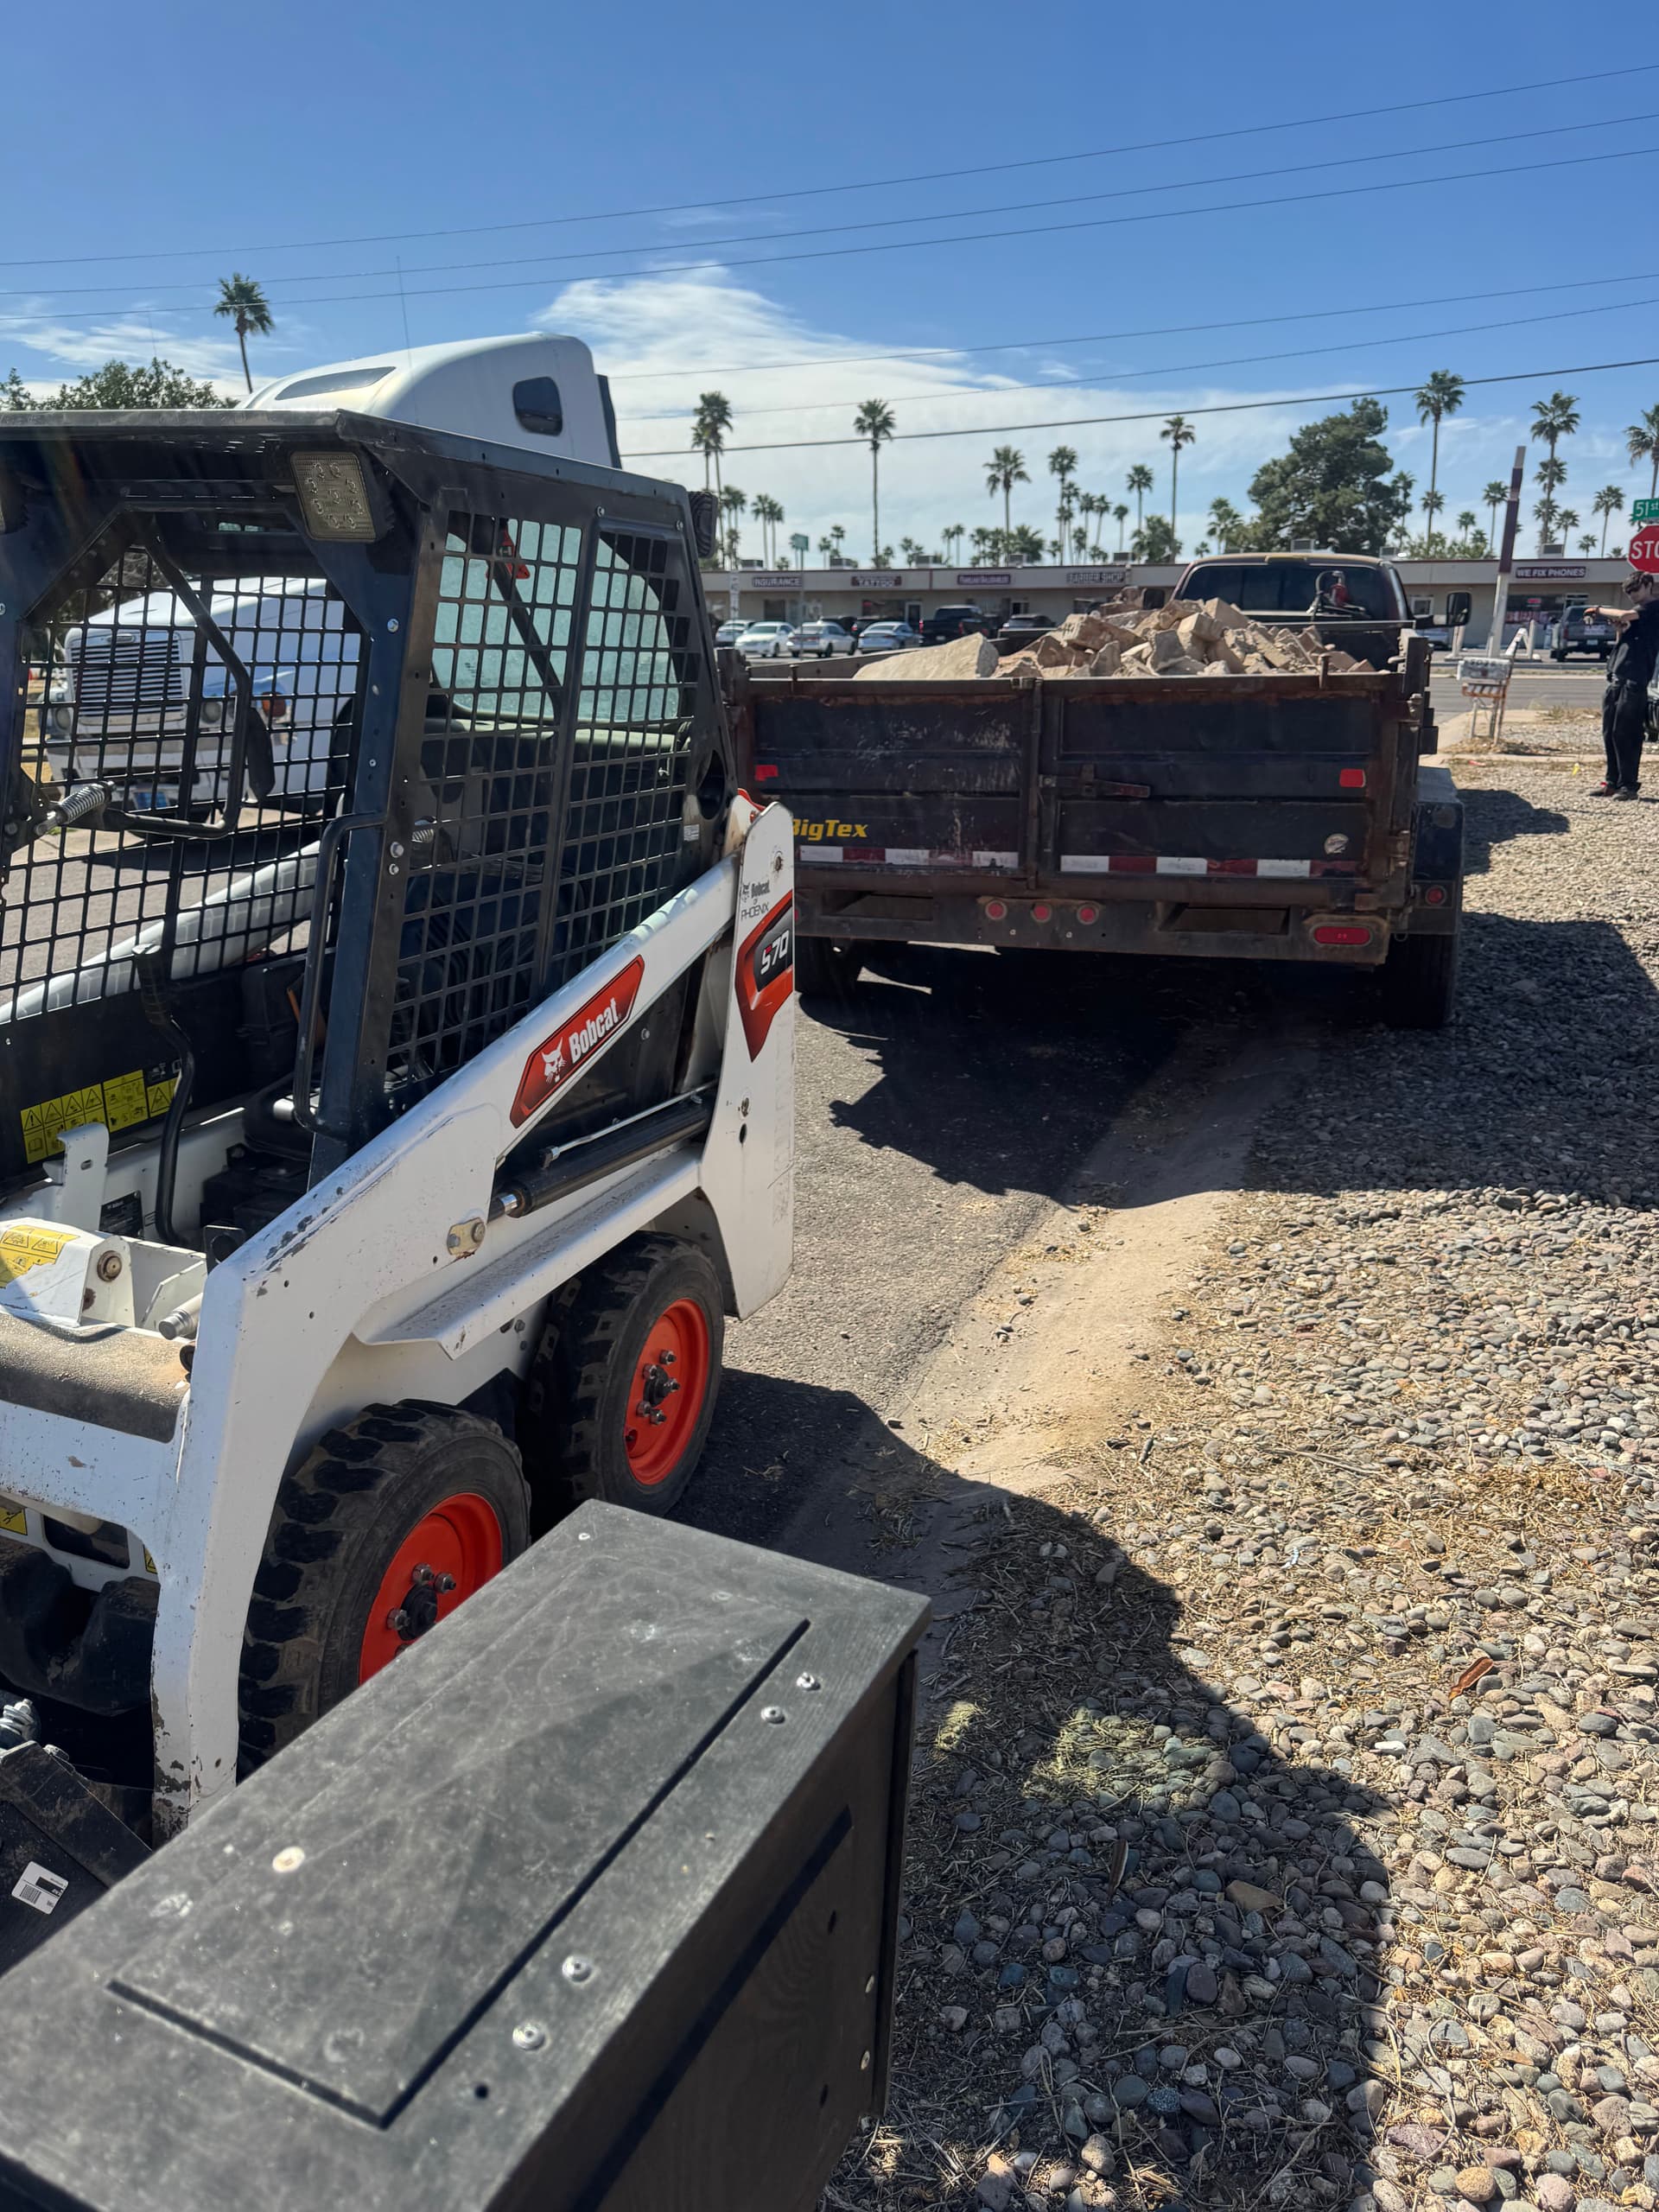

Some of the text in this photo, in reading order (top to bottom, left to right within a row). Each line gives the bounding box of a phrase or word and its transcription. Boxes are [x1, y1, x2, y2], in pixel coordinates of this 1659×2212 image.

[1517, 568, 1586, 577] WE FIX PHONES
[753, 577, 802, 588] INSURANCE
[751, 880, 770, 899] Bobcat
[741, 901, 770, 921] PHOENIX
[760, 930, 790, 976] S70
[569, 997, 620, 1064] Bobcat
